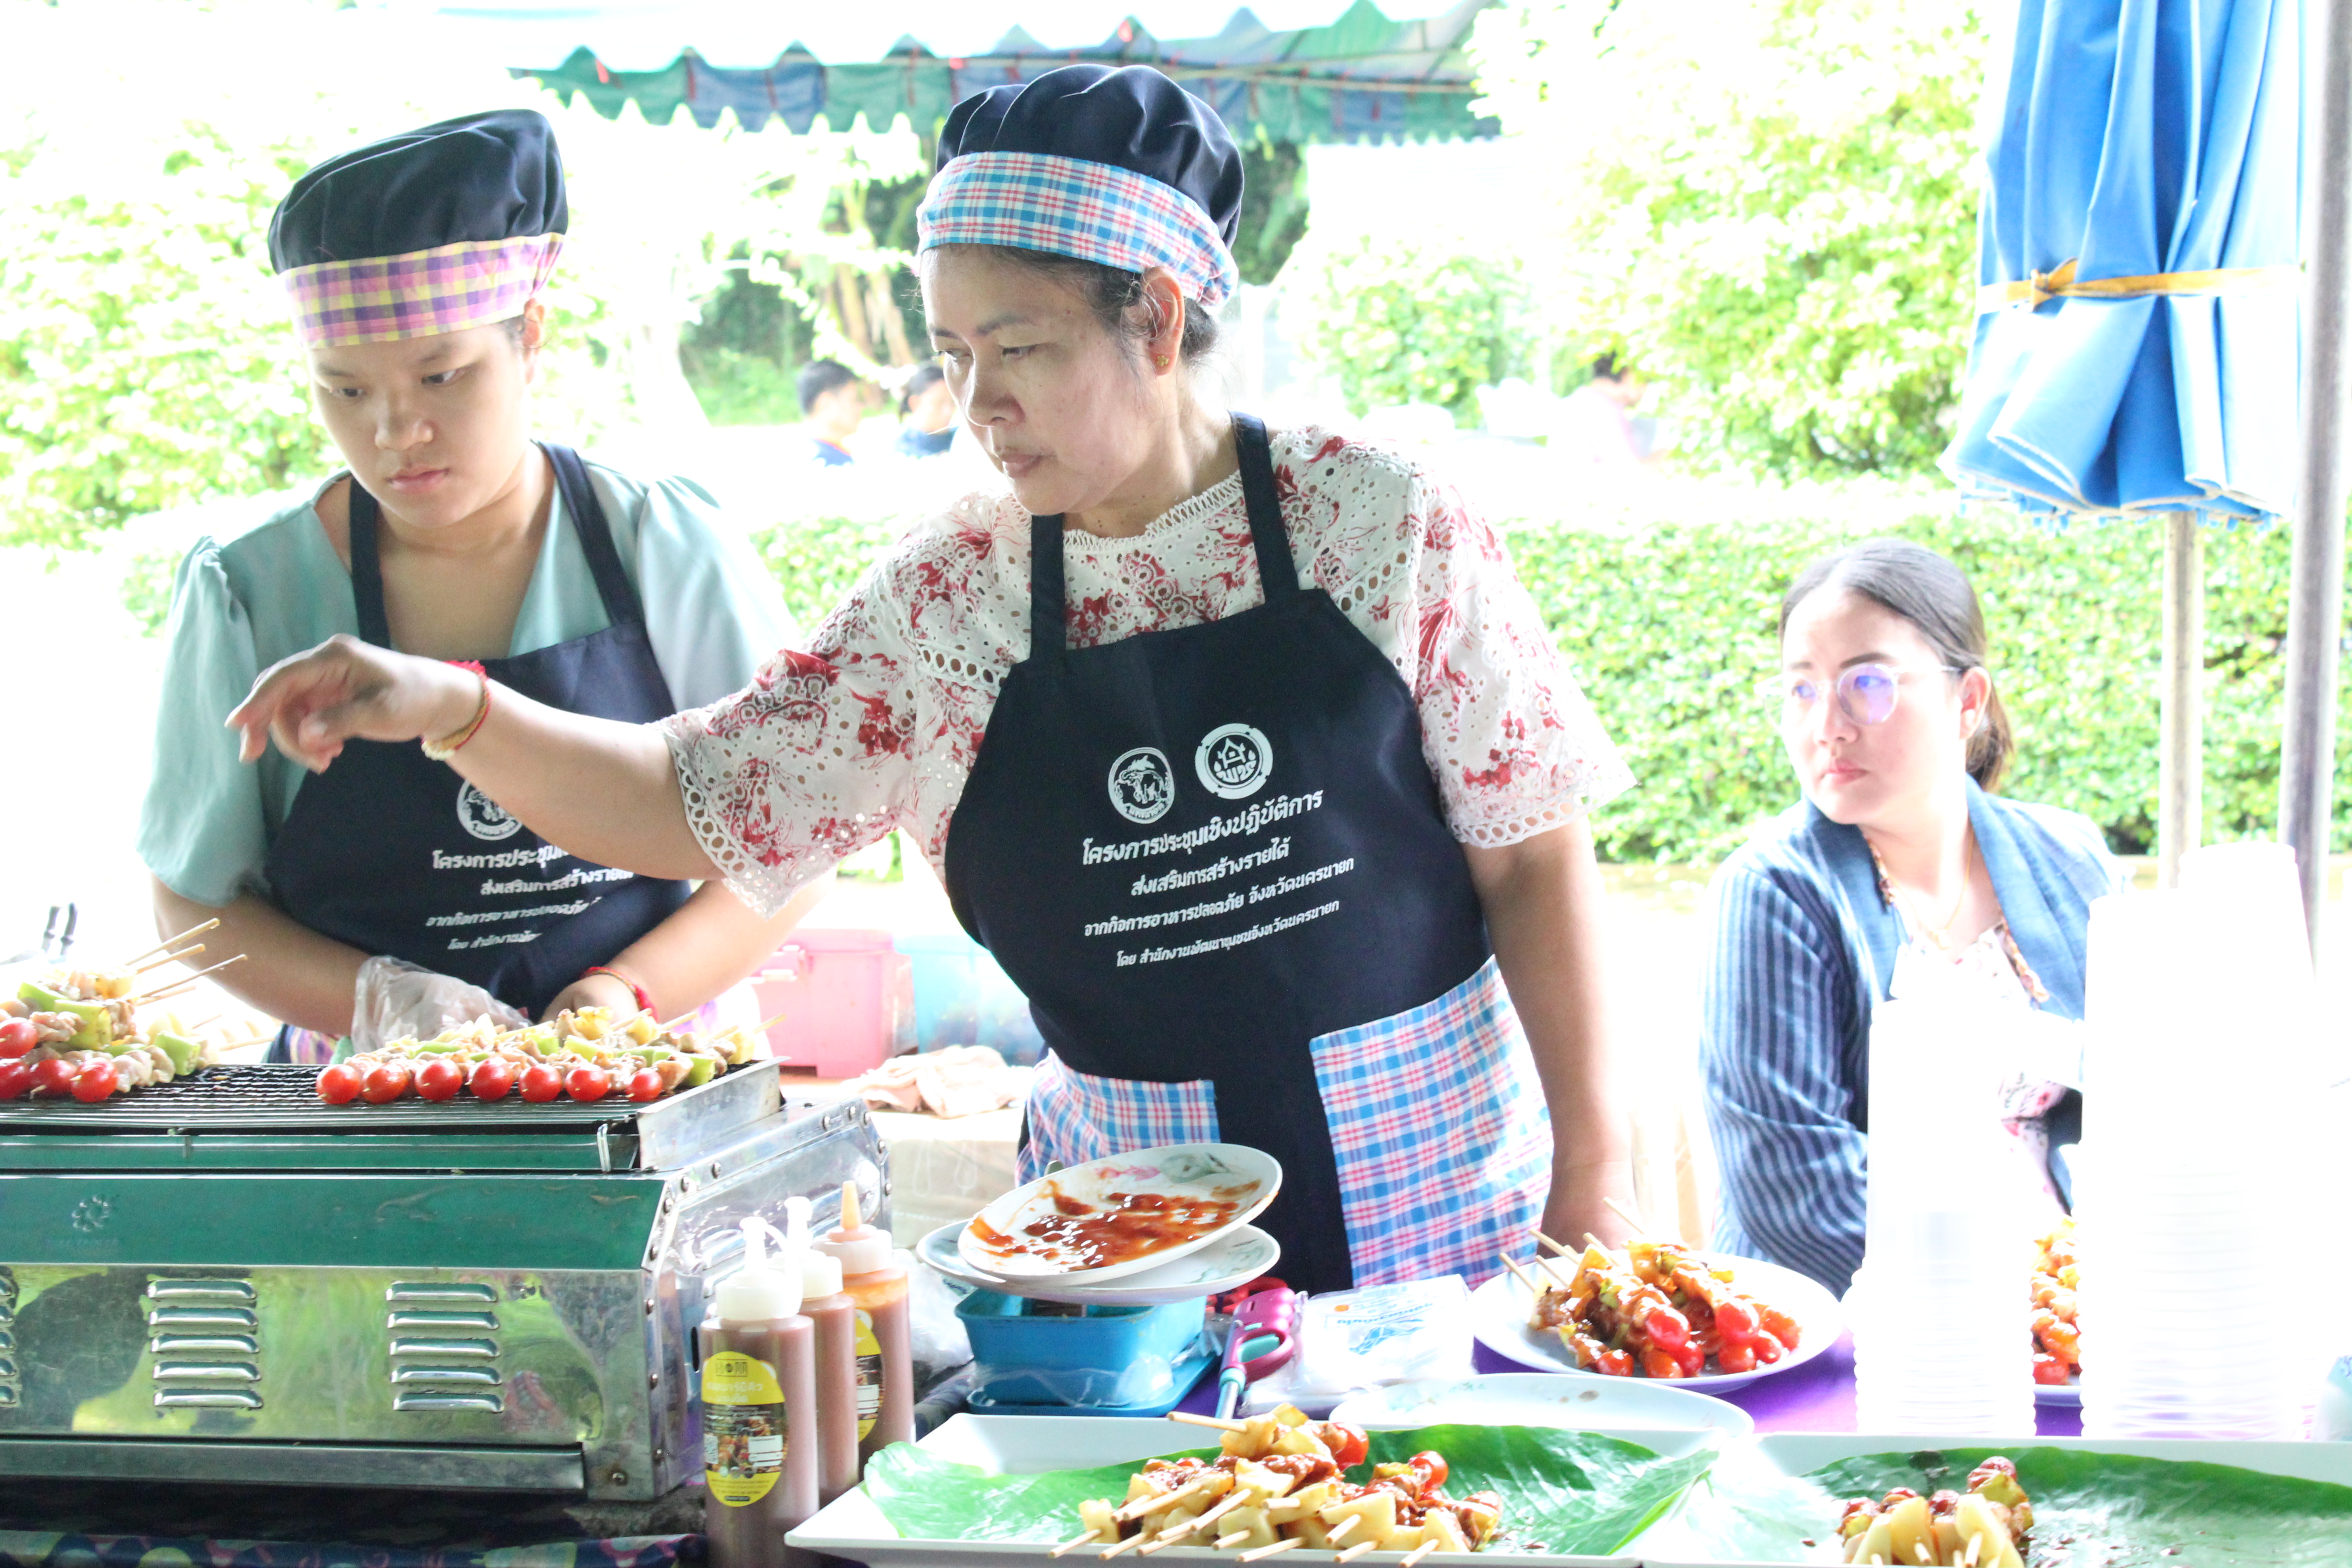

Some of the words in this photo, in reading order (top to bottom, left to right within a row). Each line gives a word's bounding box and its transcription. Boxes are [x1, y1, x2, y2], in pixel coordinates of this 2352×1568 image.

[1083, 789, 1323, 865] โครงการประชุมเชิงปฏิบัติการ
[1084, 892, 1245, 937] จากกิจการอาหารปลอดภัย
[1249, 858, 1354, 904] จังหวัดนครนายก
[1131, 836, 1292, 896] ส่งเสริมการสร้างรายได้
[1117, 950, 1137, 967] โดย
